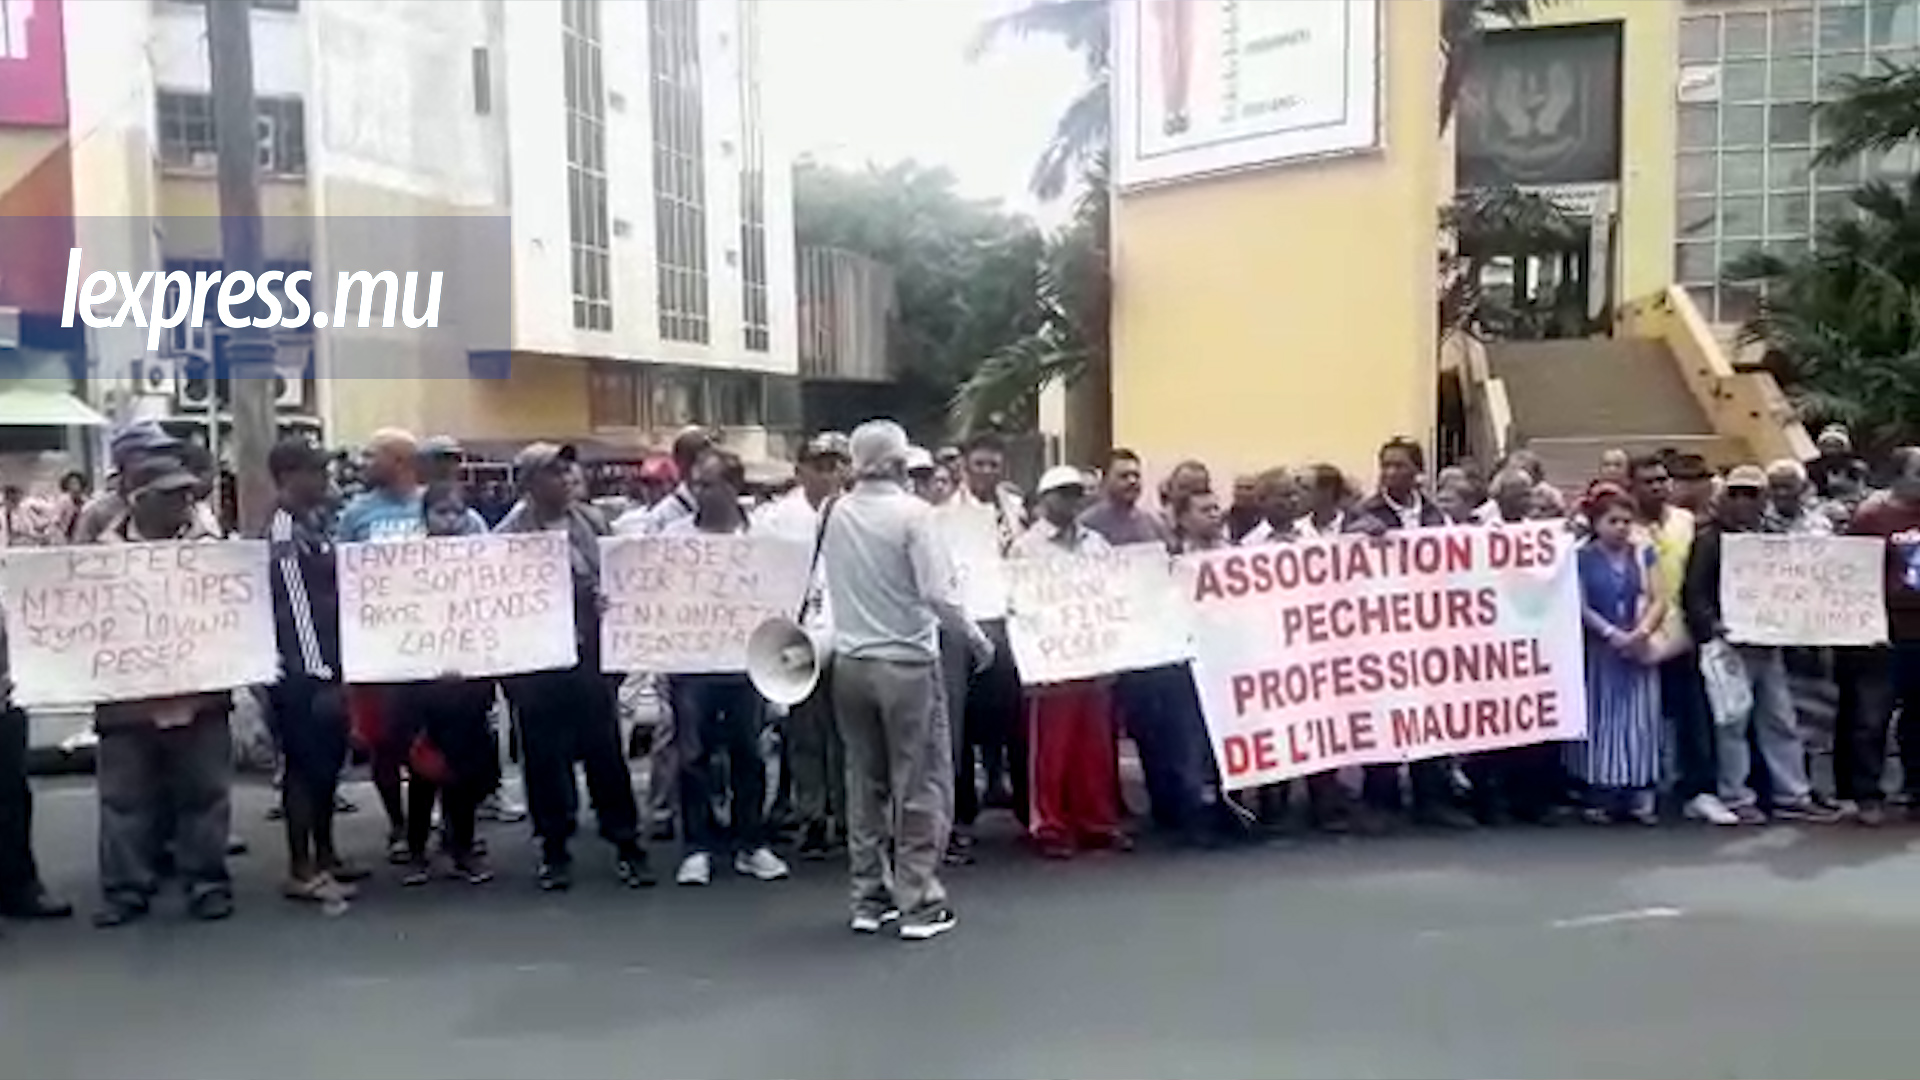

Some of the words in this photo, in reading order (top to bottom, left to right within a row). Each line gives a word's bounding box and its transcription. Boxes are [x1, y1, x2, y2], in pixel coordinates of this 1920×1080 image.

[1195, 535, 1473, 600] ASSOCIATION
[1487, 528, 1556, 570] DES
[1282, 587, 1498, 646] PECHEURS
[1232, 638, 1552, 716] PROFESSIONNEL
[1223, 730, 1276, 777] DE
[1287, 711, 1376, 766] L'ILE
[1390, 691, 1558, 748] MAURICE
